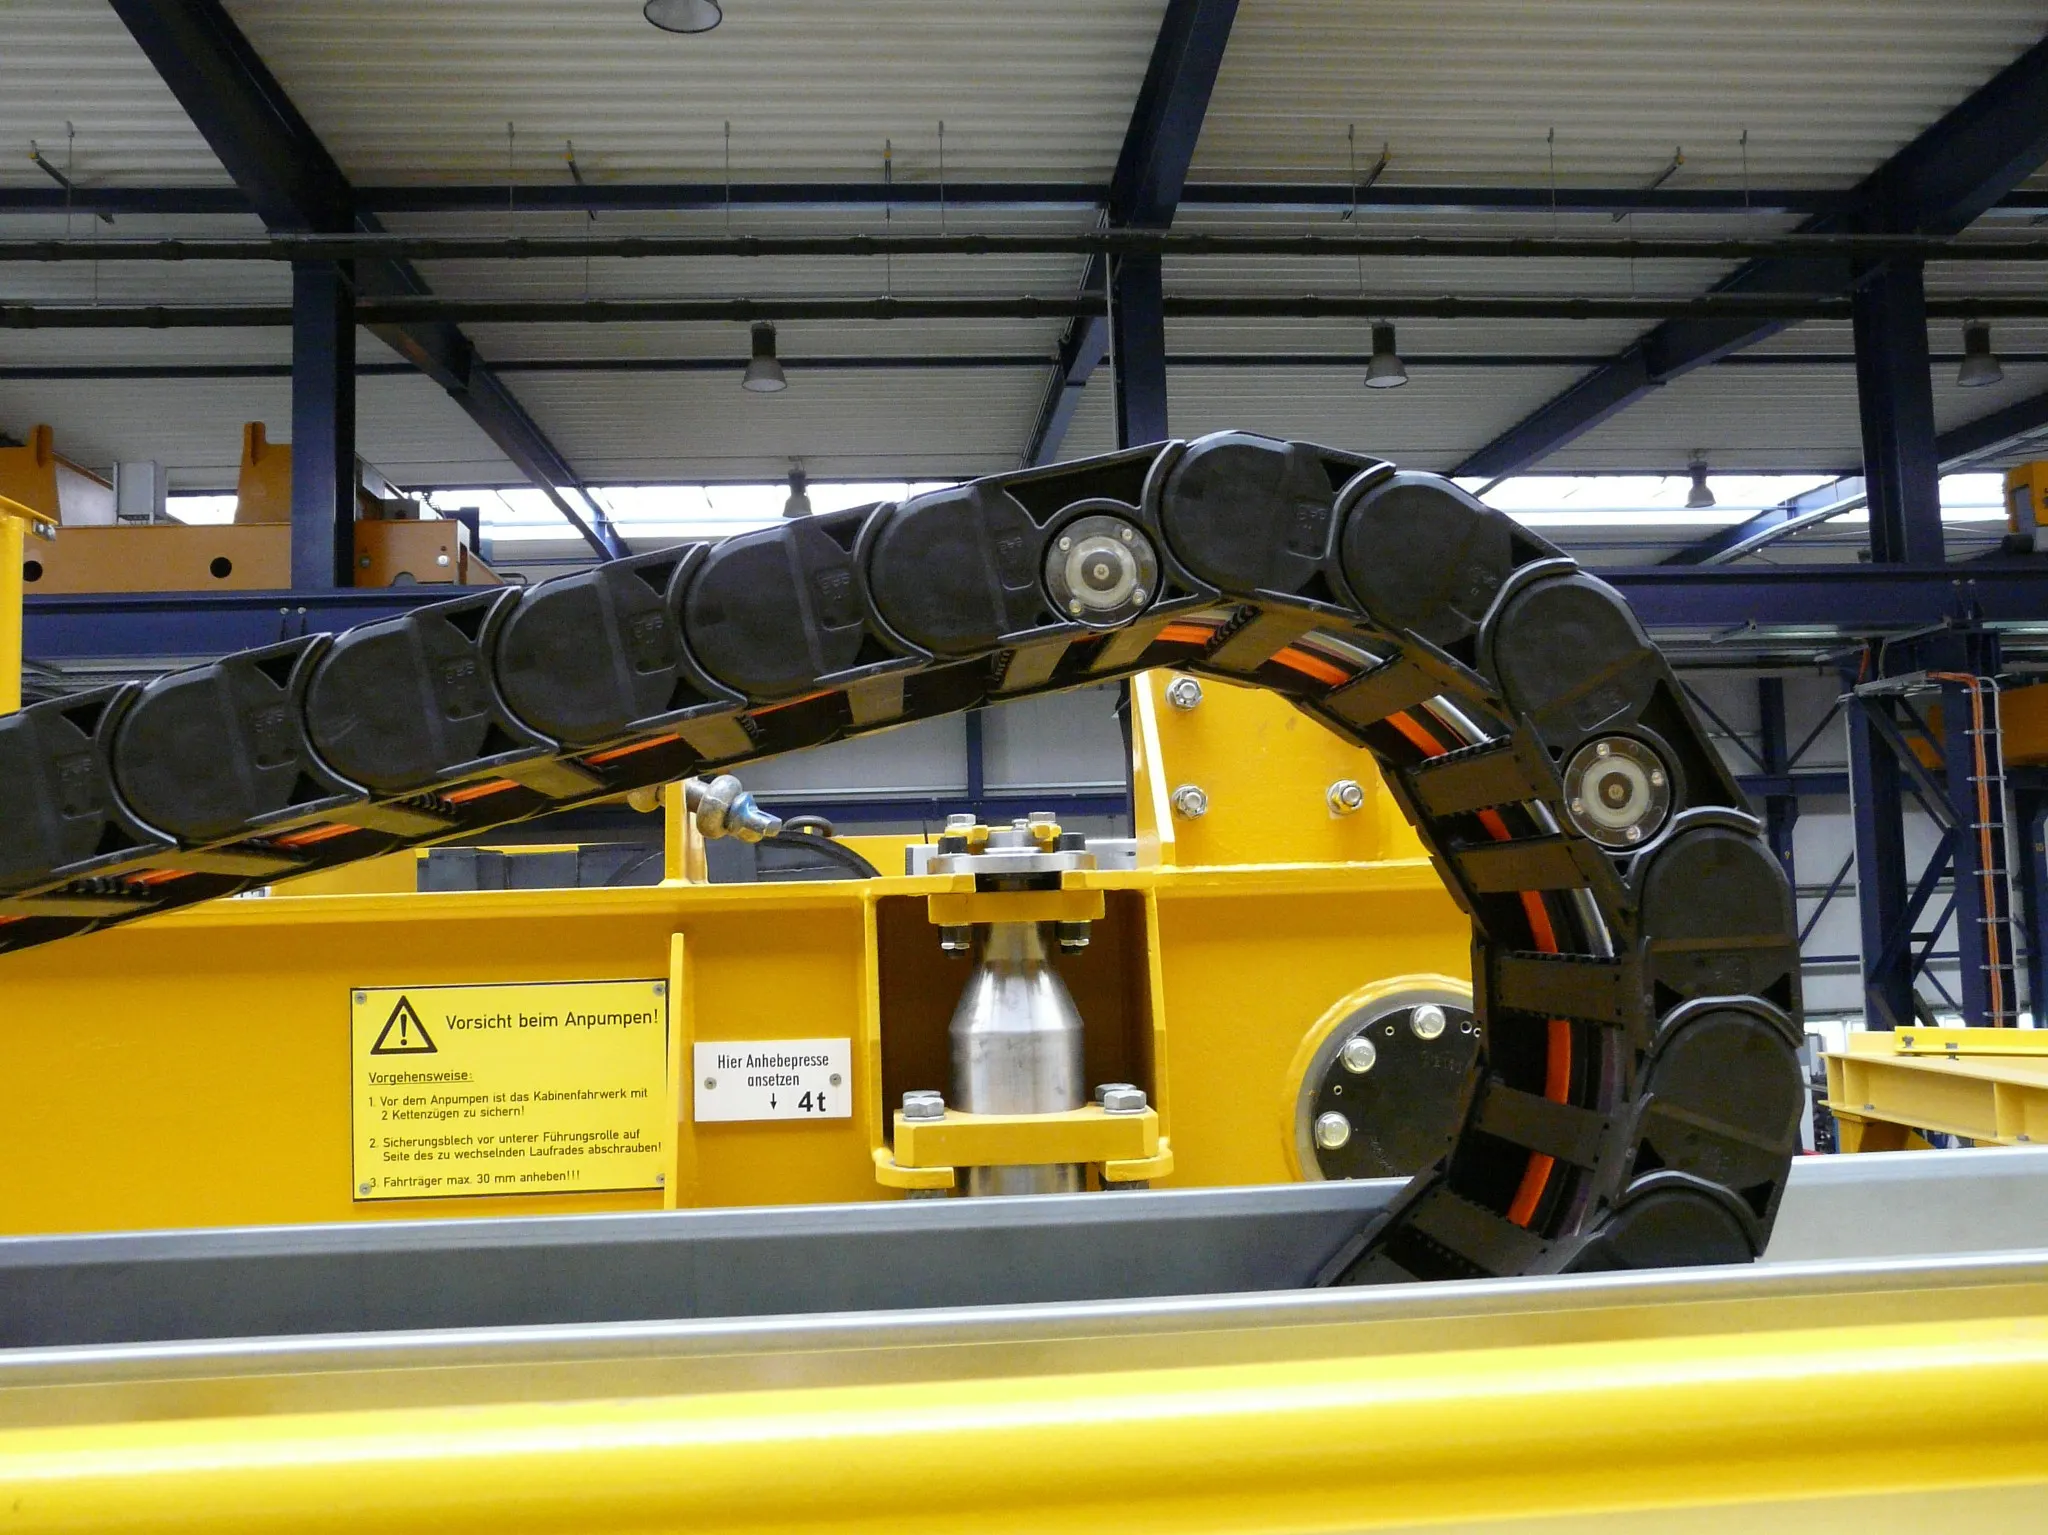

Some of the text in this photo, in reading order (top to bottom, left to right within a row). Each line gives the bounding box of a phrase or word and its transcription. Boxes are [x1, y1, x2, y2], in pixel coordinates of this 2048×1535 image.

[446, 1008, 658, 1030] Vorsicht beim Anpumpen!
[718, 1053, 829, 1070] Hier Anhebepresse
[368, 1070, 474, 1086] Vorgehensweise:
[748, 1073, 800, 1087] ansetzen
[380, 1096, 399, 1106] Vor
[402, 1095, 426, 1106] dem
[430, 1094, 489, 1107] Anpumpen
[493, 1093, 506, 1103] ist
[510, 1092, 530, 1102] das
[534, 1088, 627, 1101] Kabinenfahrwerk
[630, 1088, 648, 1098] mit
[381, 1105, 524, 1121] 2 Kettenzügen zu sichern!
[383, 1134, 473, 1149] Sicherungsblech
[477, 1136, 495, 1144] vor
[499, 1134, 538, 1145] unterer
[543, 1130, 619, 1145] Führungsrolle
[623, 1128, 640, 1140] auf
[383, 1141, 661, 1162] Seite des zu wechselnden Laufrades abschrauben!
[384, 1176, 443, 1188] Fahrträger
[476, 1173, 490, 1184] 30
[494, 1175, 516, 1184] mm
[520, 1170, 580, 1182] anheben!!!
